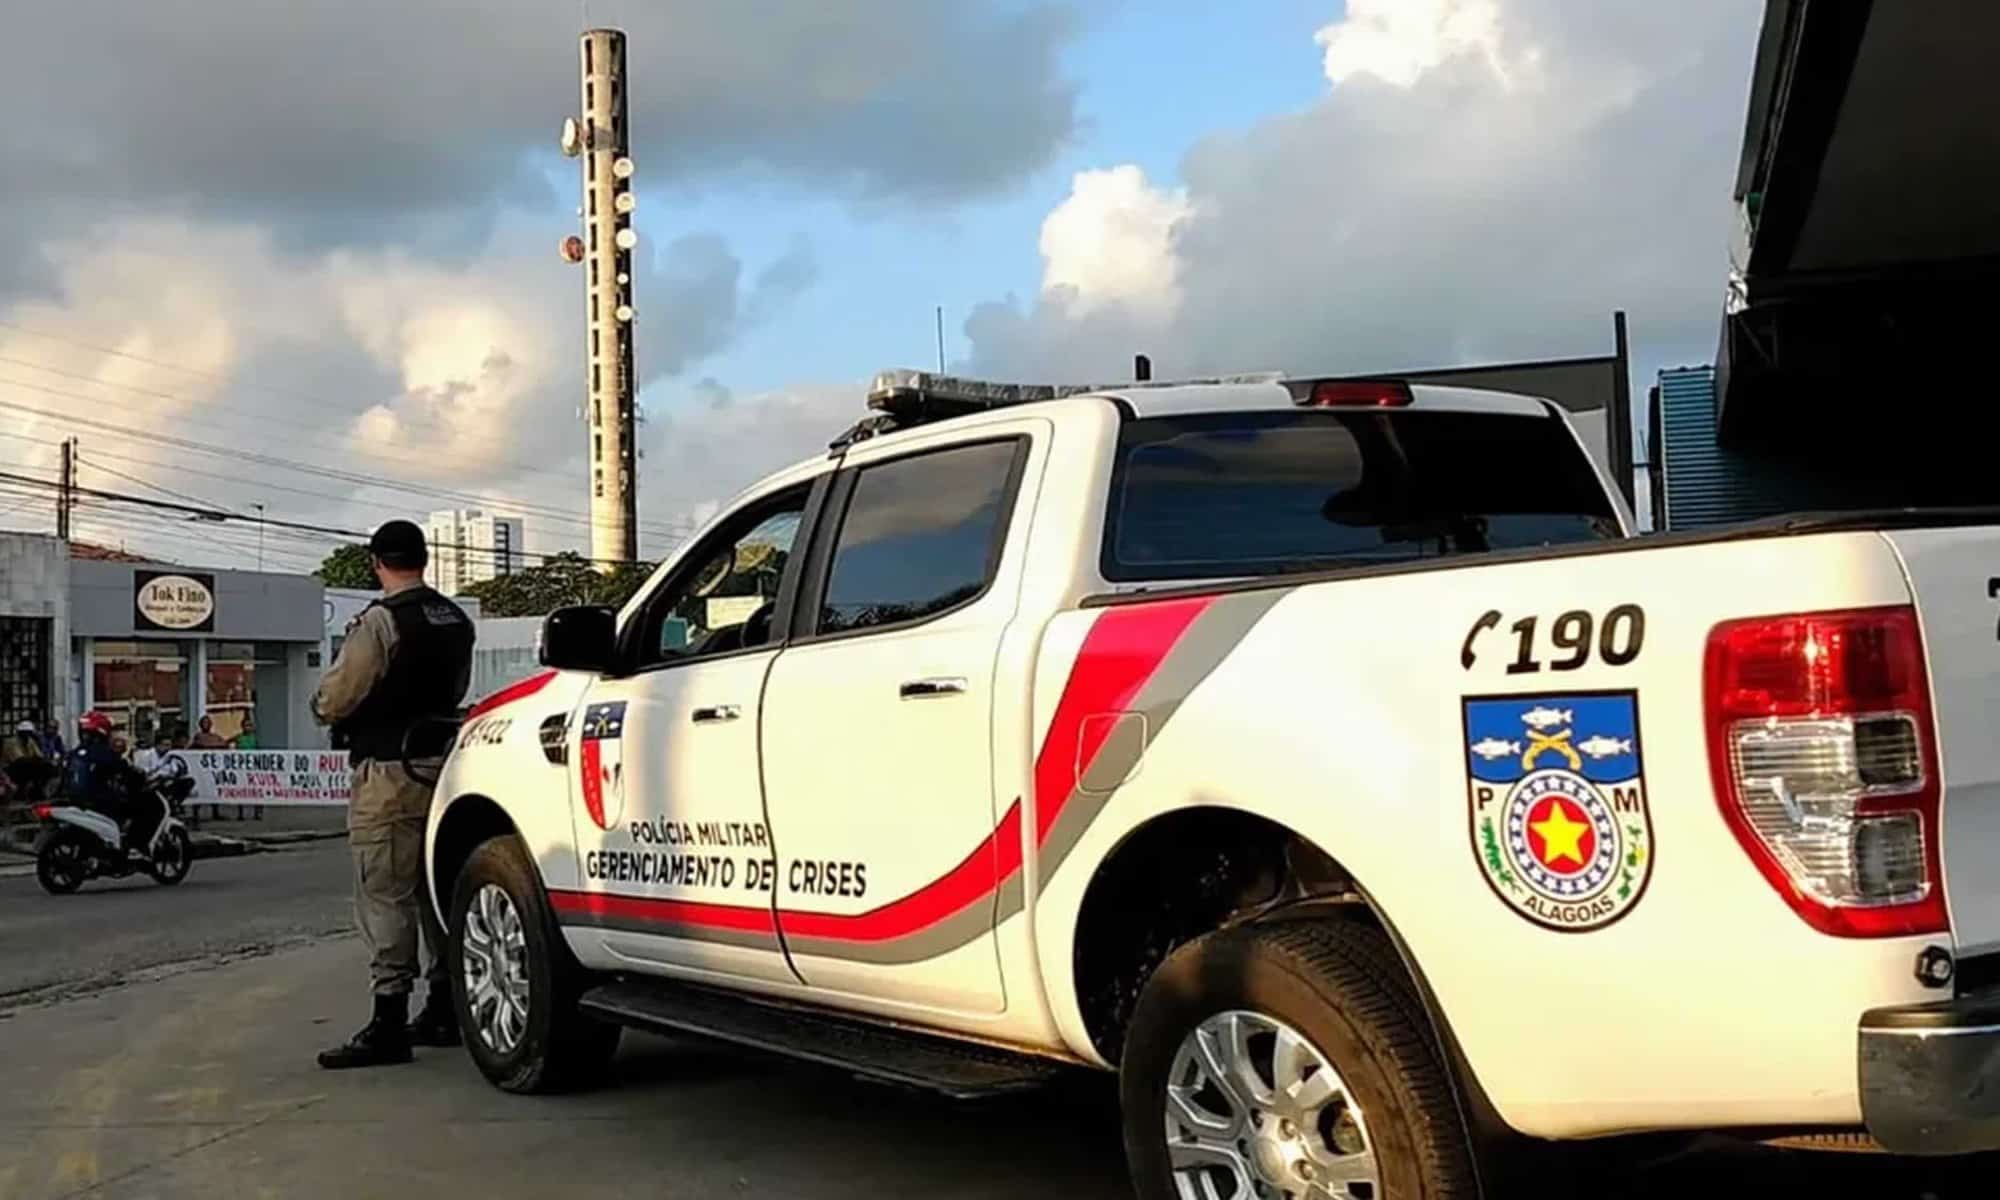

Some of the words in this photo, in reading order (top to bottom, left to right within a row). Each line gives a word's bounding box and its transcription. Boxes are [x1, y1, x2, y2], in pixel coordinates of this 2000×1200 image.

[151, 585, 175, 601] Tok
[177, 586, 206, 603] Fino
[1506, 604, 1645, 675] 190
[200, 753, 218, 769] SE
[223, 753, 285, 771] DEPENDER
[294, 754, 309, 772] DO
[1477, 787, 1495, 812] P
[1614, 787, 1641, 813] M
[631, 815, 695, 847] POLÍCIA
[696, 822, 768, 848] MILITAR
[586, 850, 736, 889] GERENCIAMENTO
[744, 858, 773, 891] DE
[788, 859, 867, 898] CRISES
[1524, 894, 1615, 923] ALAGOAS
